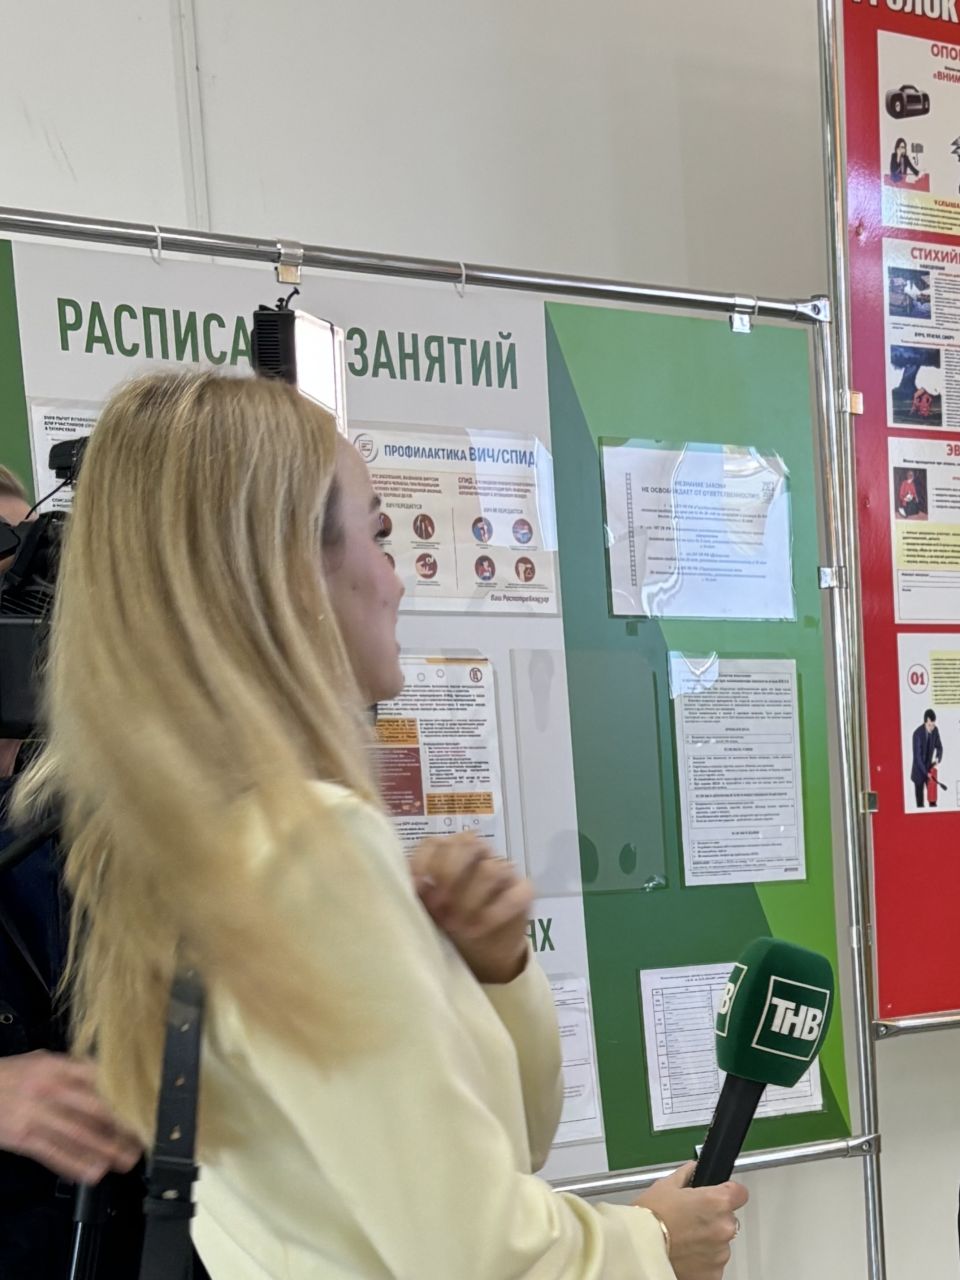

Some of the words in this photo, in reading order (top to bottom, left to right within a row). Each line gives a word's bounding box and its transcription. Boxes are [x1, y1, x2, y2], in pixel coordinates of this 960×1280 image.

[57, 297, 252, 365] РАСПИСА
[347, 327, 519, 390] ЗАНЯТИЙ
[384, 445, 467, 462] ПРОФИЛАКТИКА
[469, 447, 538, 468] ВИЧ/СПИД
[911, 672, 926, 686] 01
[770, 996, 823, 1041] ТНВ
